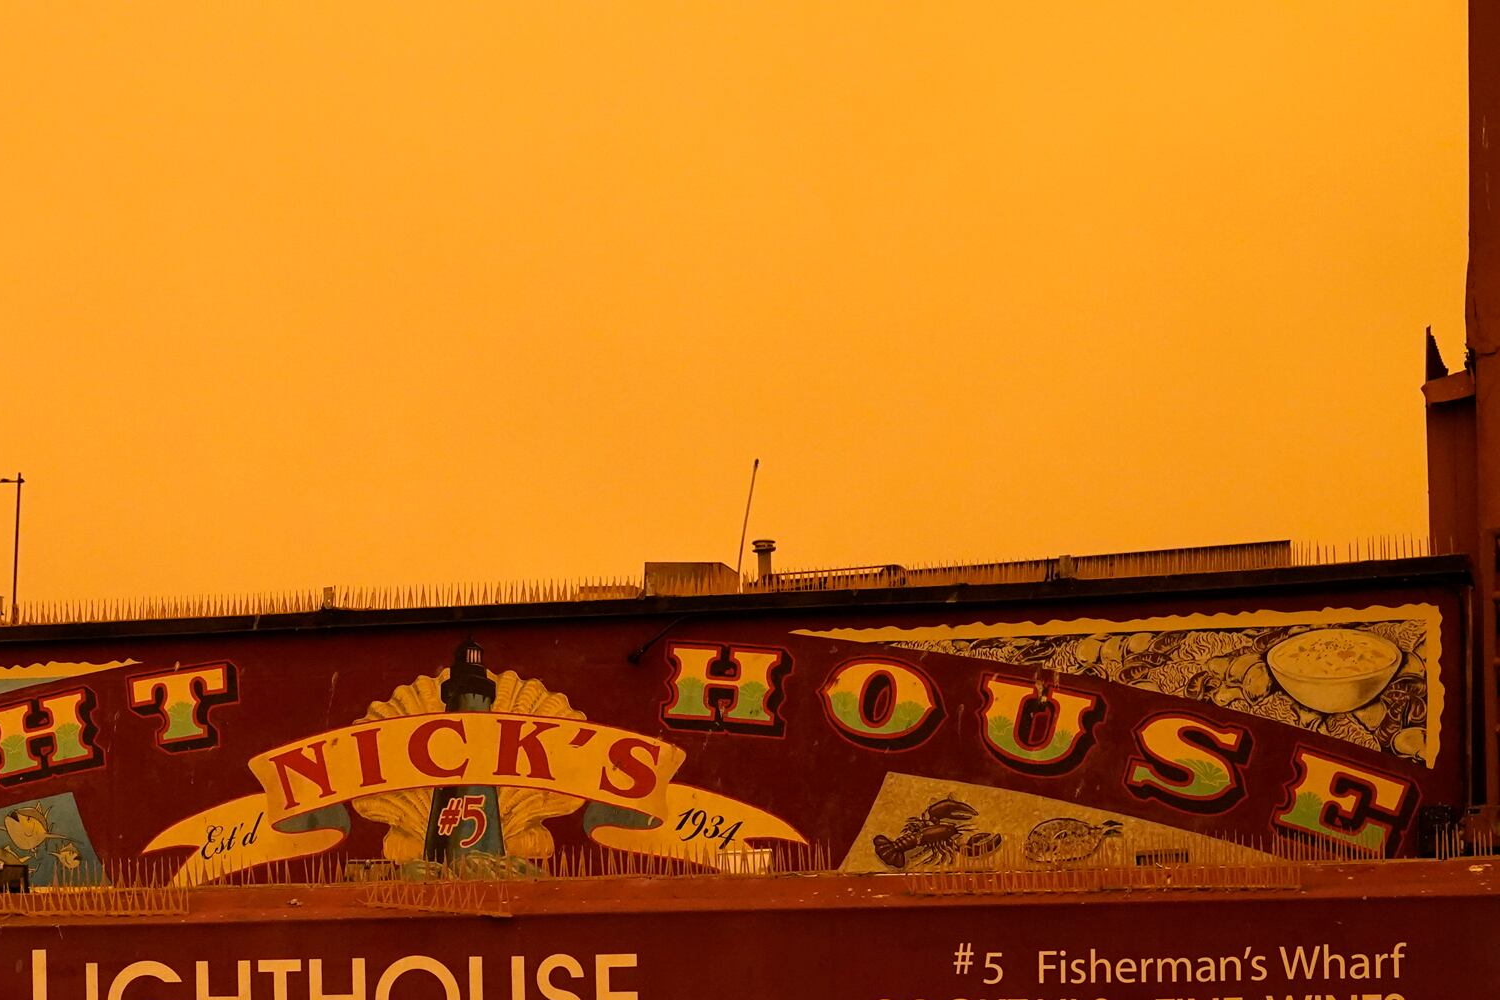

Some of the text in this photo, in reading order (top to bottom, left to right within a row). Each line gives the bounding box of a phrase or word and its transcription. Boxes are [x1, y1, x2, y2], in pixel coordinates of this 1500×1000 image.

[269, 719, 664, 810] NICK'S
[662, 640, 1419, 855] HOUSE
[200, 811, 265, 860] Est'd
[439, 796, 486, 848] #5
[673, 808, 743, 847] 1934
[954, 942, 1407, 984] #5 Fisherman's Wharf
